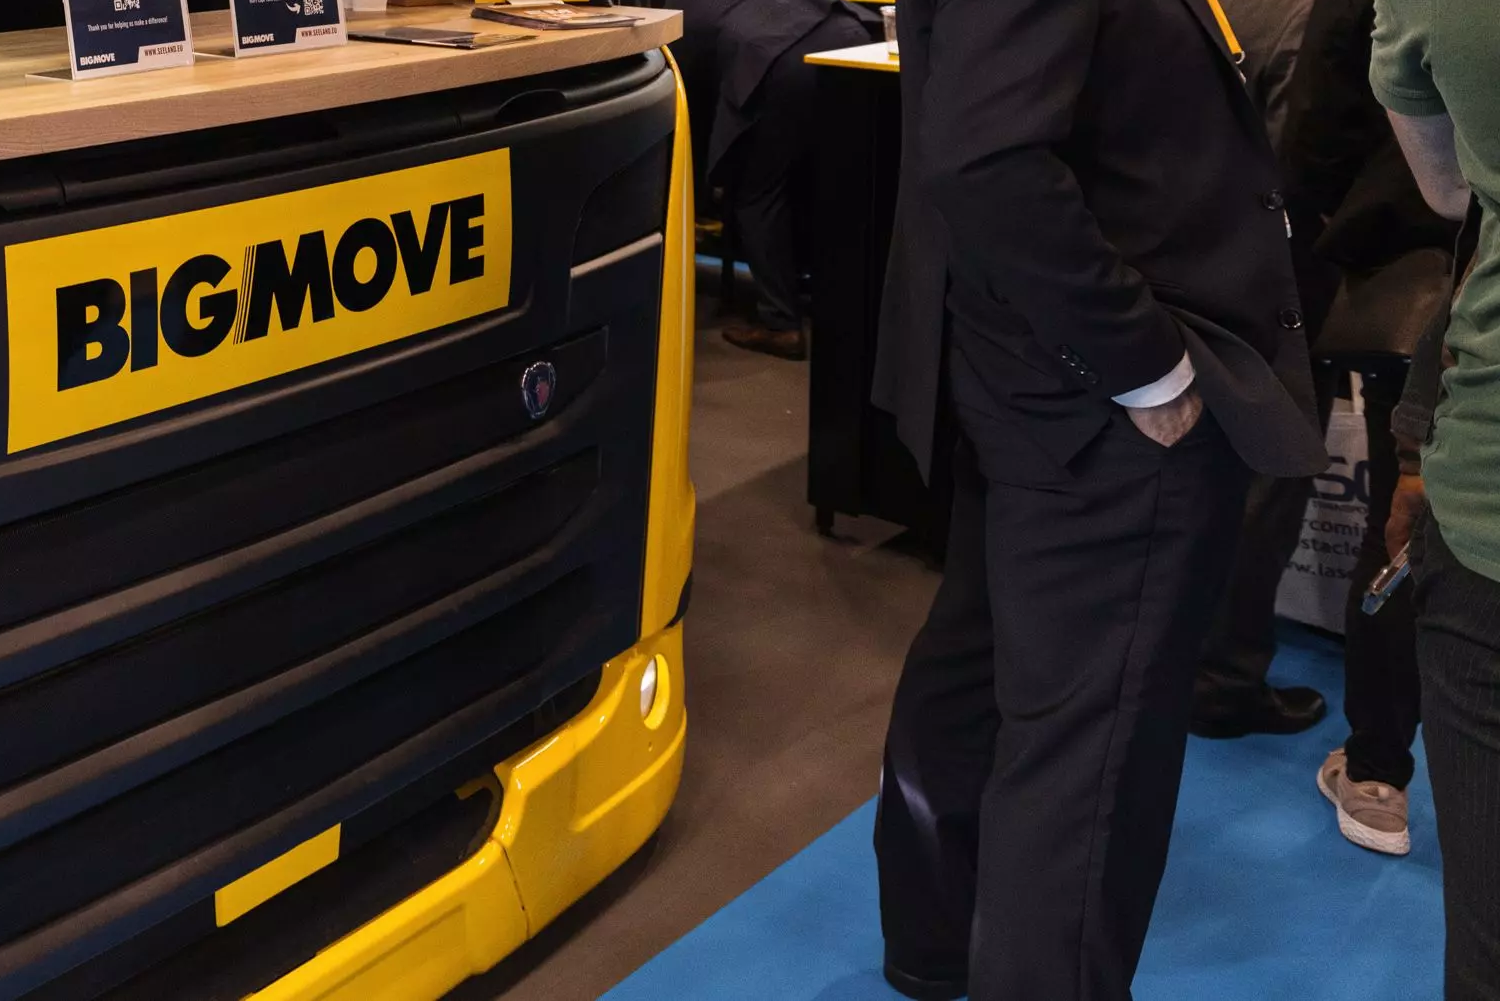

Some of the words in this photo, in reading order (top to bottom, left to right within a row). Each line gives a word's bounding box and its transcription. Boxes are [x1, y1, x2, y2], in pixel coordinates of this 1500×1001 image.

[115, 21, 129, 29] helping
[148, 16, 168, 24] difference!
[242, 34, 274, 44] BIGMOVE
[144, 44, 184, 56] WWW.SEELAND.EU
[80, 53, 115, 66] BIGMOVE
[56, 192, 484, 392] BIGMOVE
